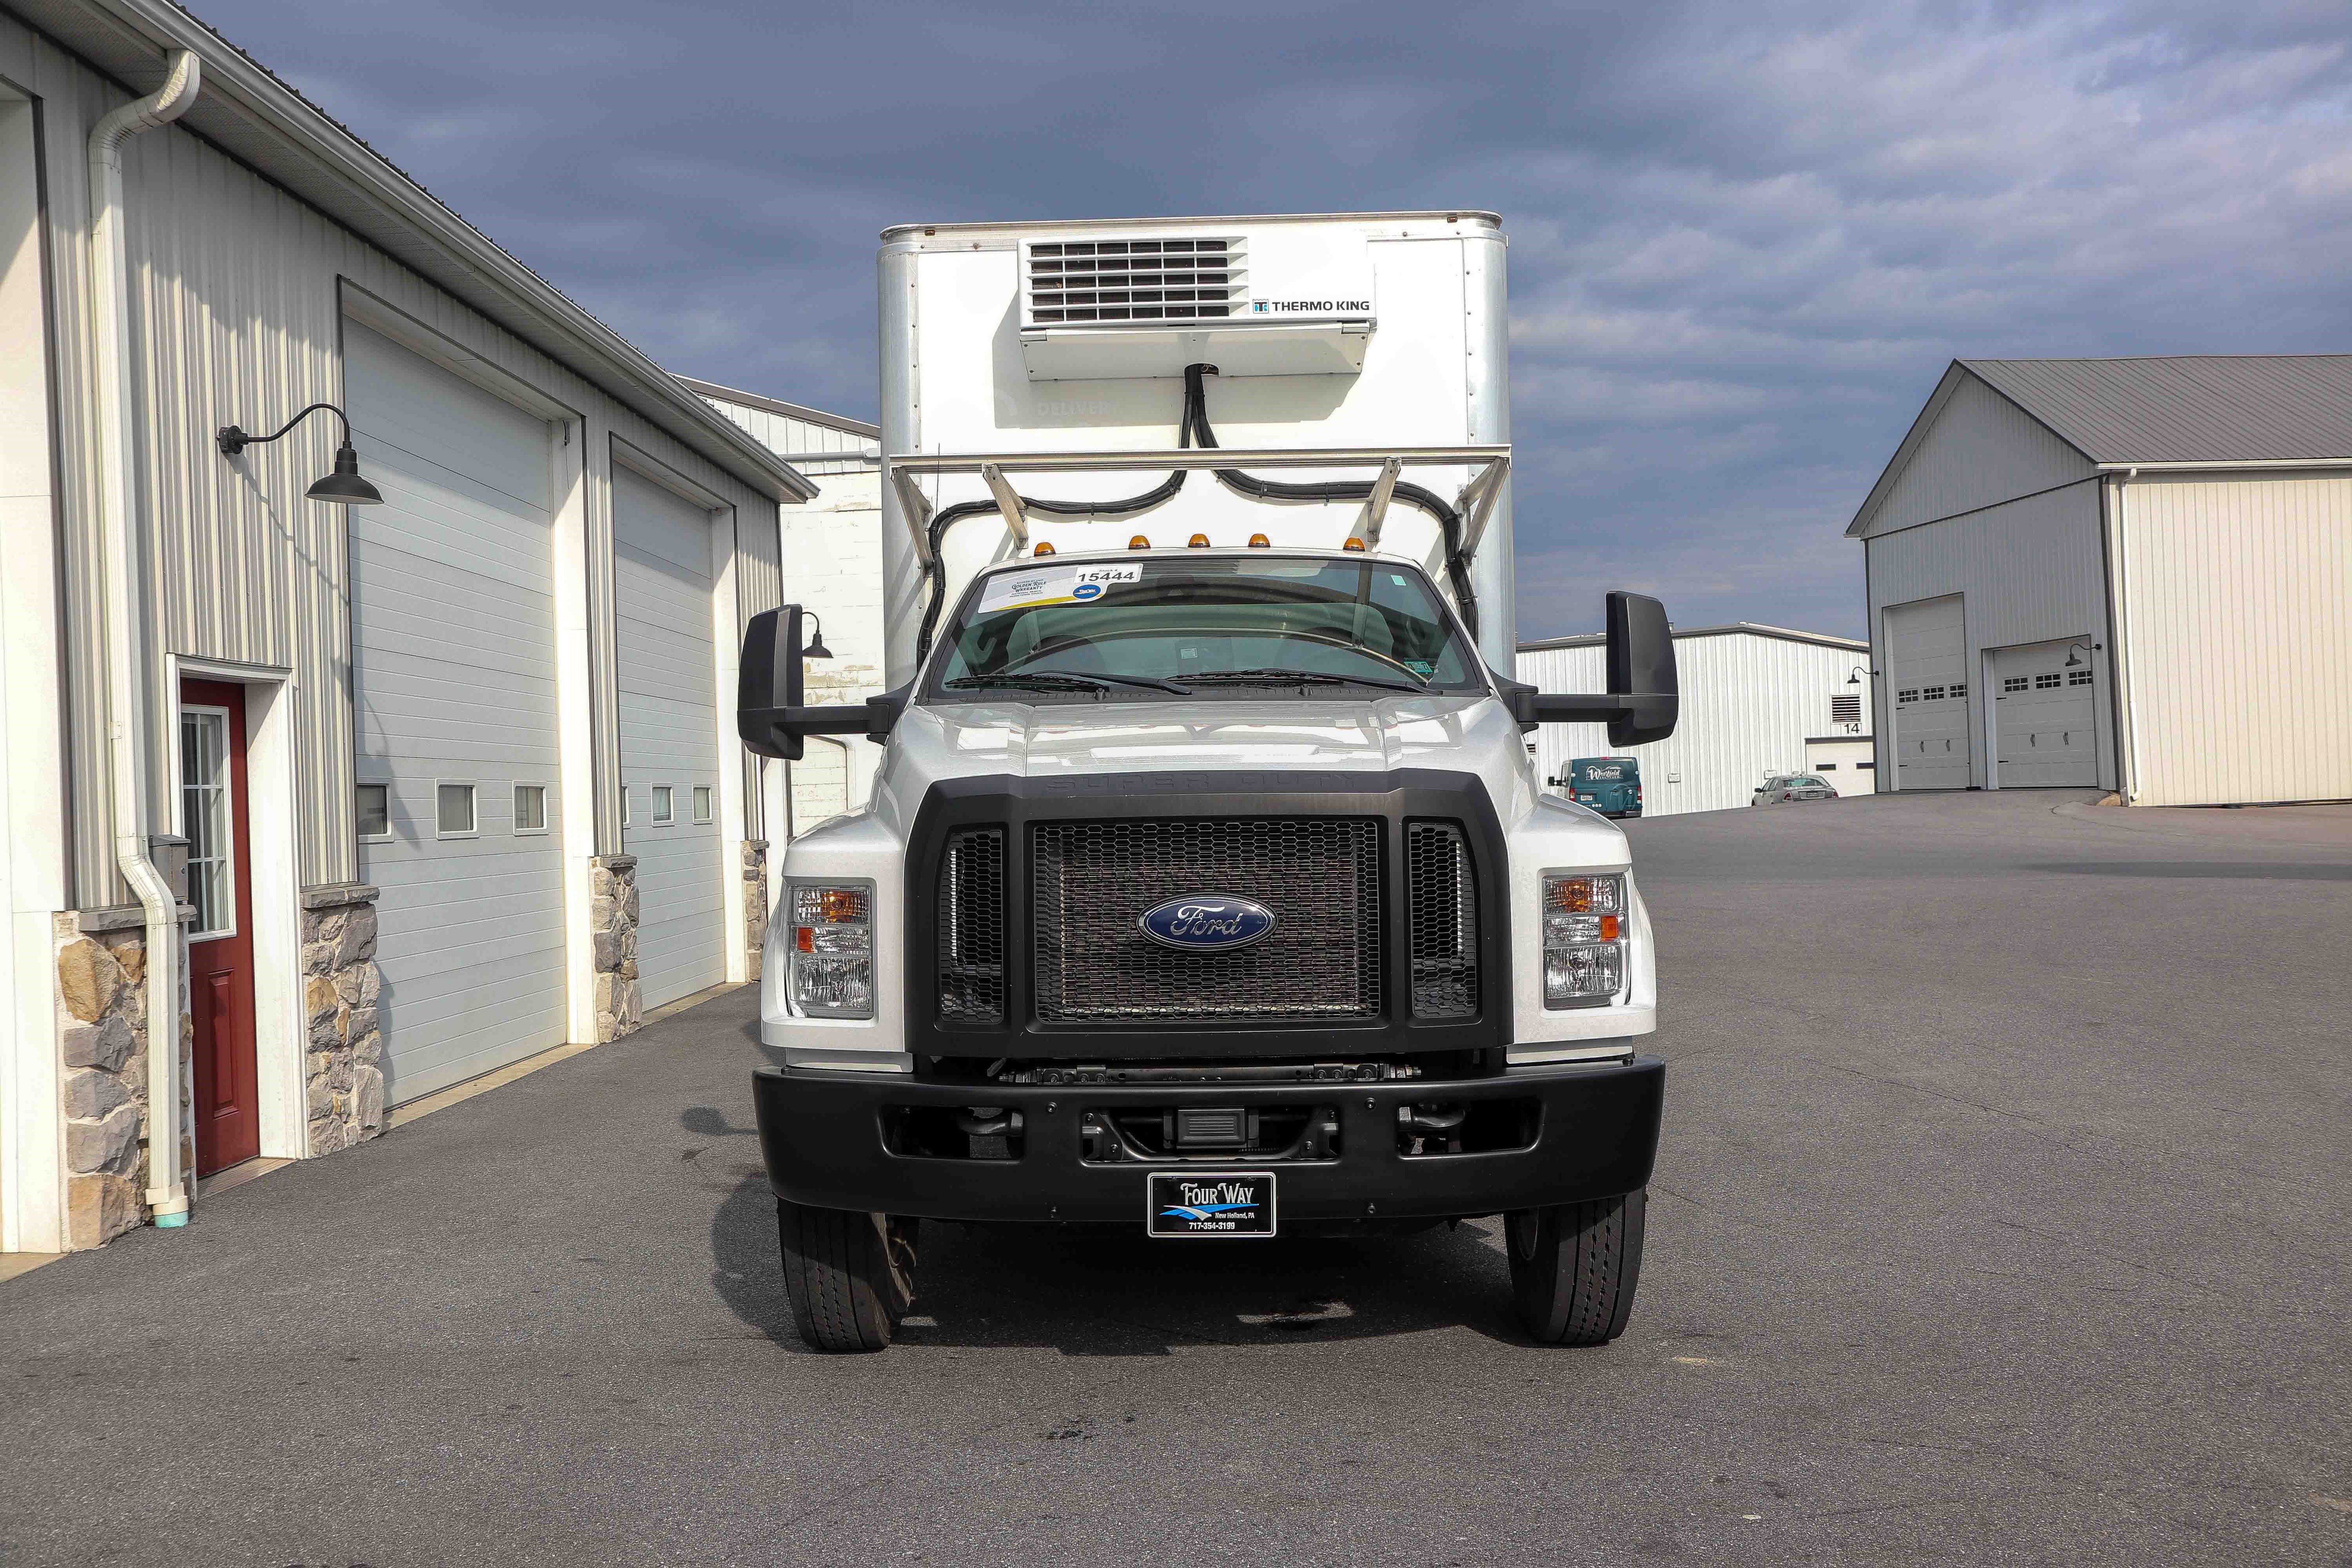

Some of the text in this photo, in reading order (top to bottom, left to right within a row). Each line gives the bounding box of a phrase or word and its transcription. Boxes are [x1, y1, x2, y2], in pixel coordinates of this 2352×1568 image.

[1272, 301, 1370, 311] THERMO KING
[1078, 572, 1134, 582] 15444
[1844, 723, 1860, 734] 14
[1047, 773, 1209, 791] SUPER
[1170, 905, 1244, 935] Ford
[1189, 1222, 1235, 1230] 717-354-3199
